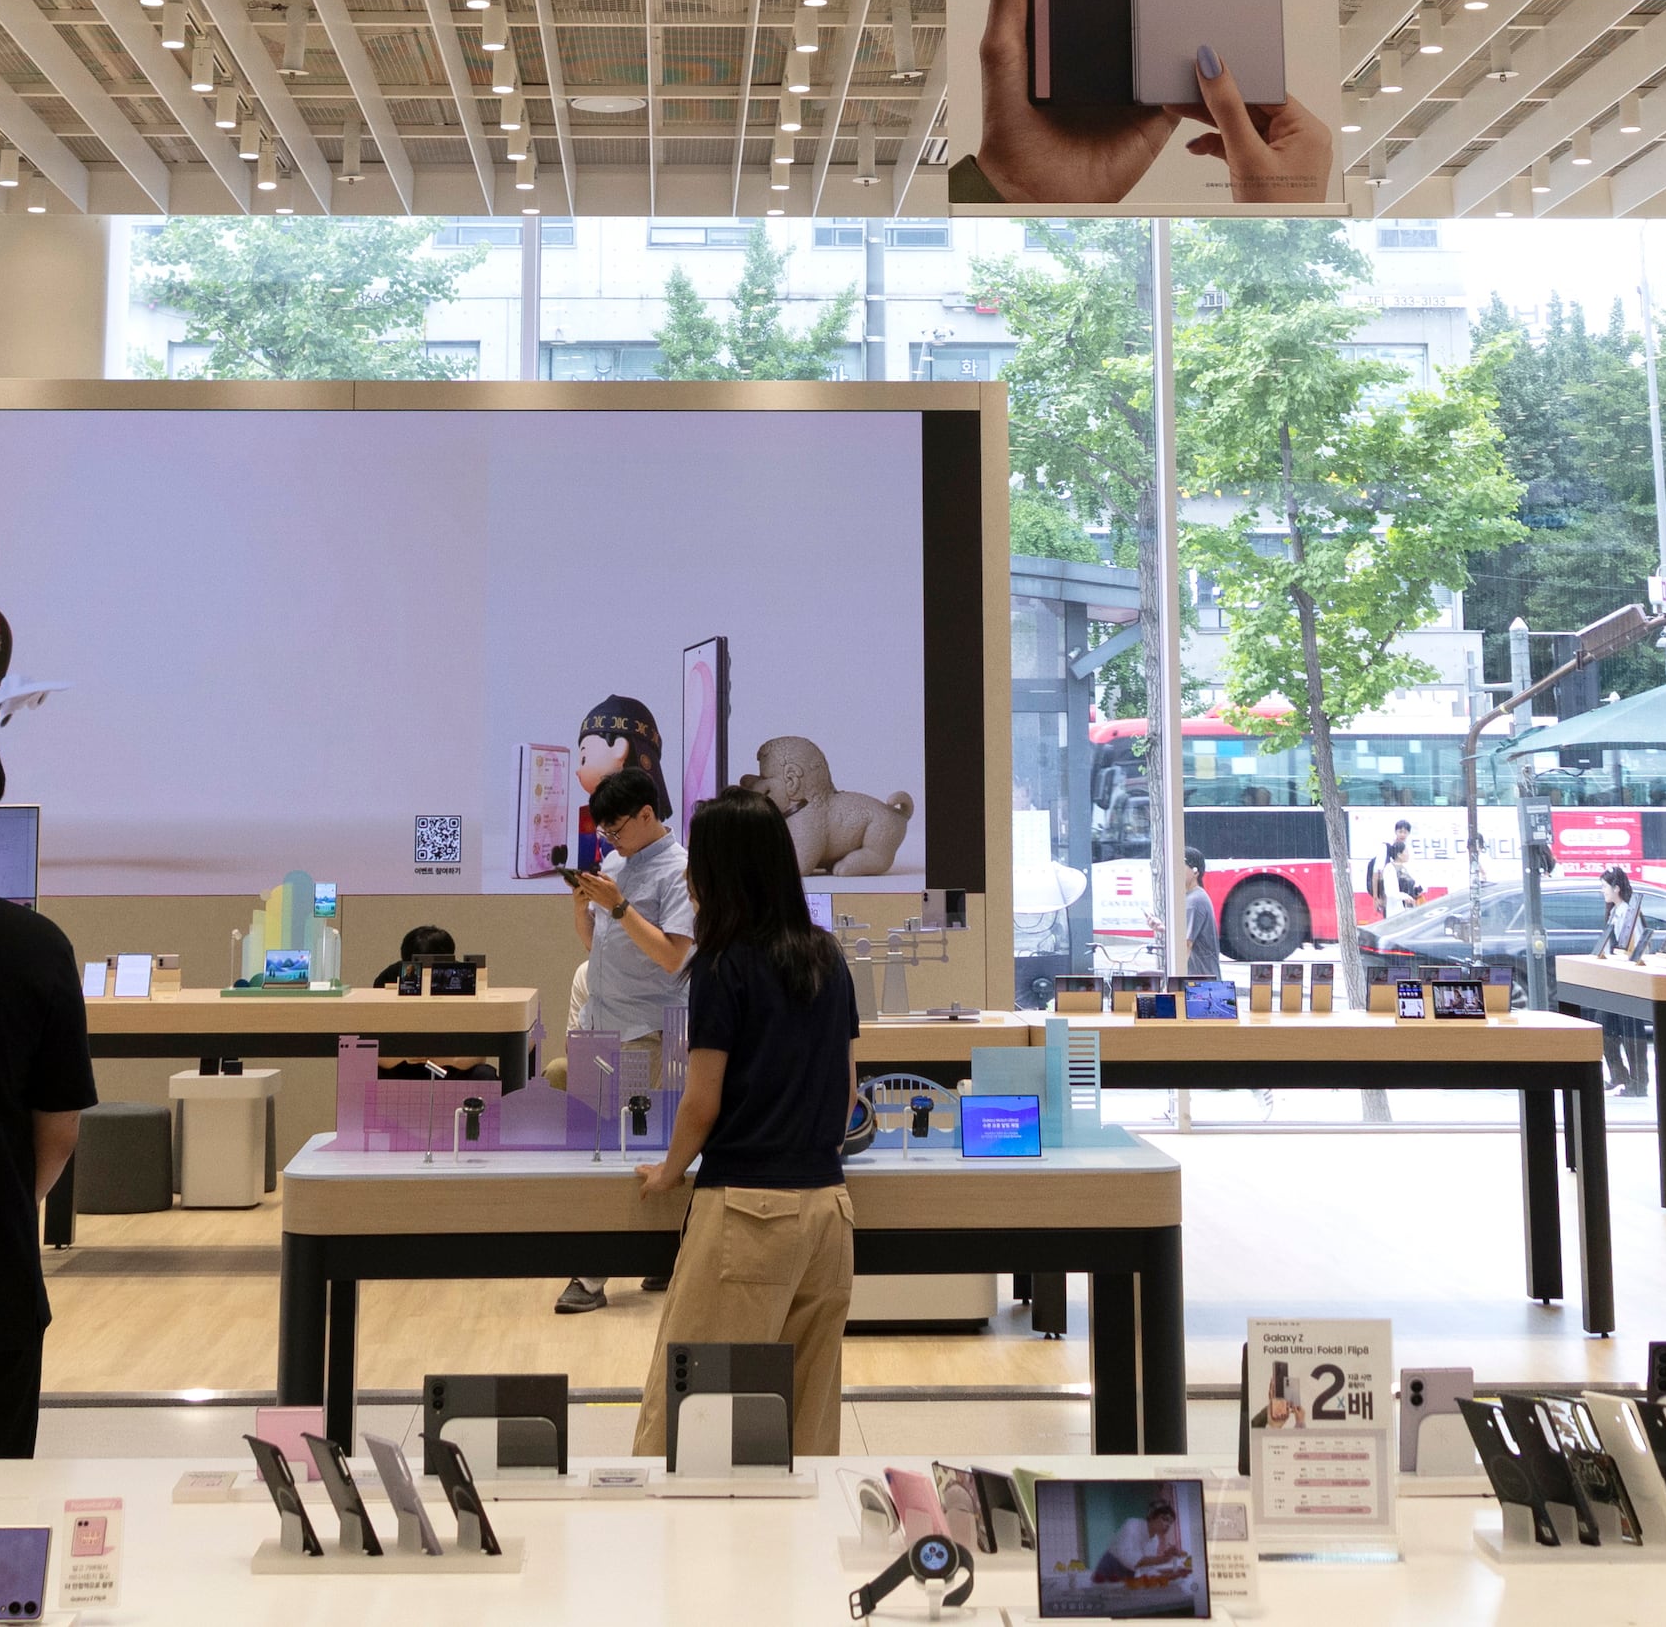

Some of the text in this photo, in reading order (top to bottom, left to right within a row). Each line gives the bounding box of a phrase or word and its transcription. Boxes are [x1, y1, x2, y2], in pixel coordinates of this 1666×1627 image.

[1393, 296, 1446, 306] 333-3133
[1263, 1334, 1304, 1344] Galaxy Z
[1263, 1346, 1369, 1357] Fold8 Ultra Fold8 Flip8
